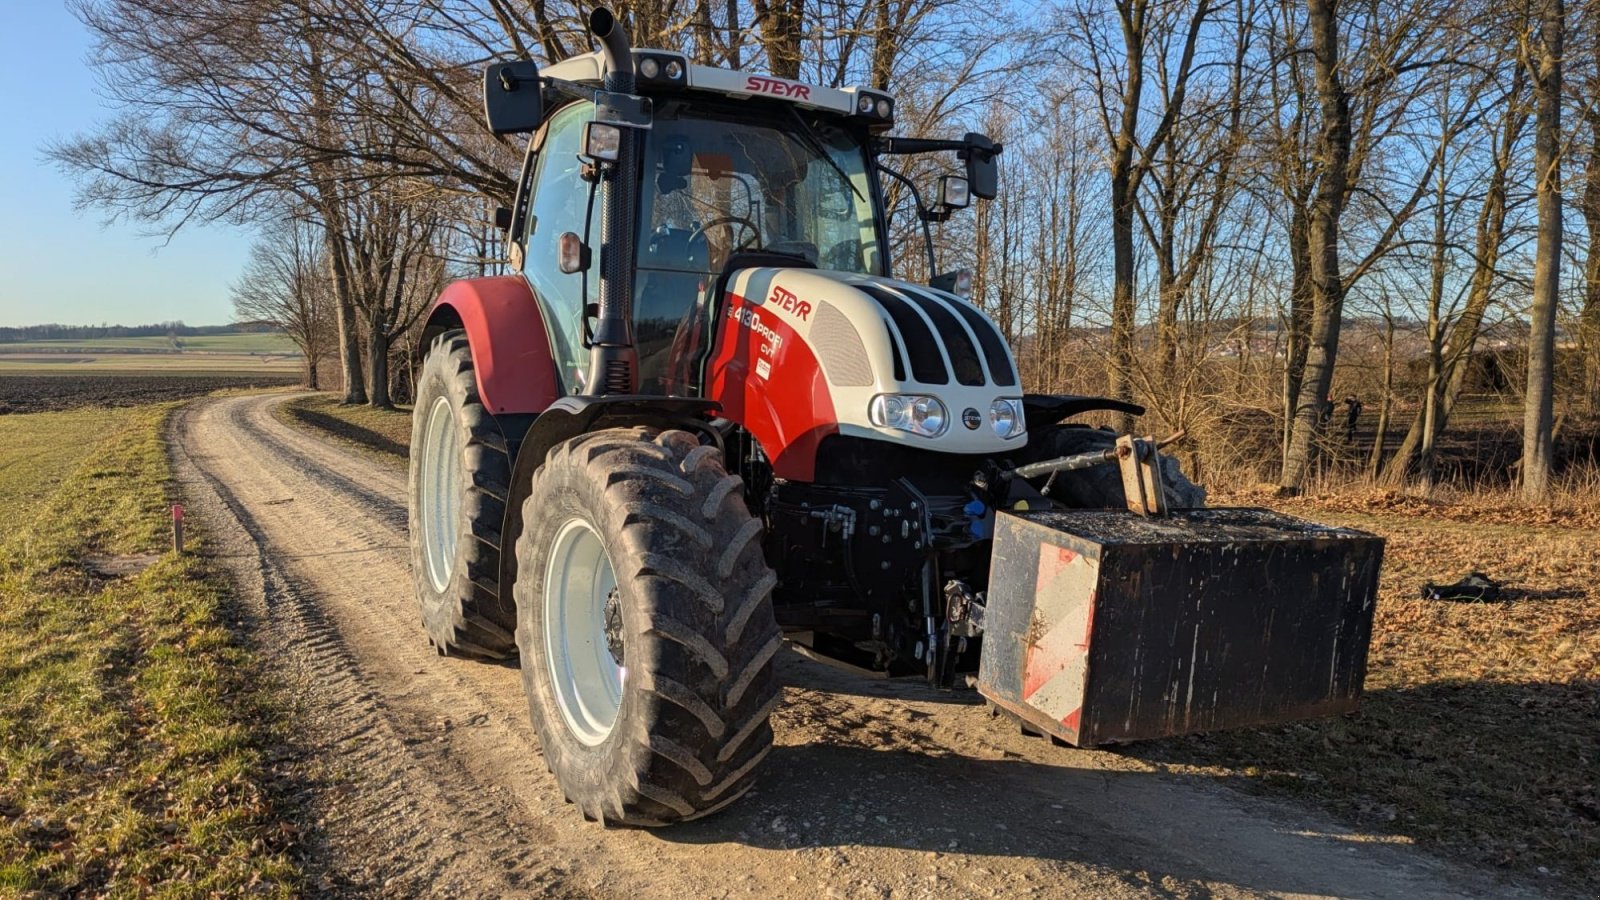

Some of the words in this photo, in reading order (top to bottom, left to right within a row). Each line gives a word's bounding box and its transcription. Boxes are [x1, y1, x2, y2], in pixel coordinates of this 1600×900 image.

[745, 76, 810, 100] STEYR
[769, 285, 812, 322] STEYR
[760, 343, 775, 358] CVT
